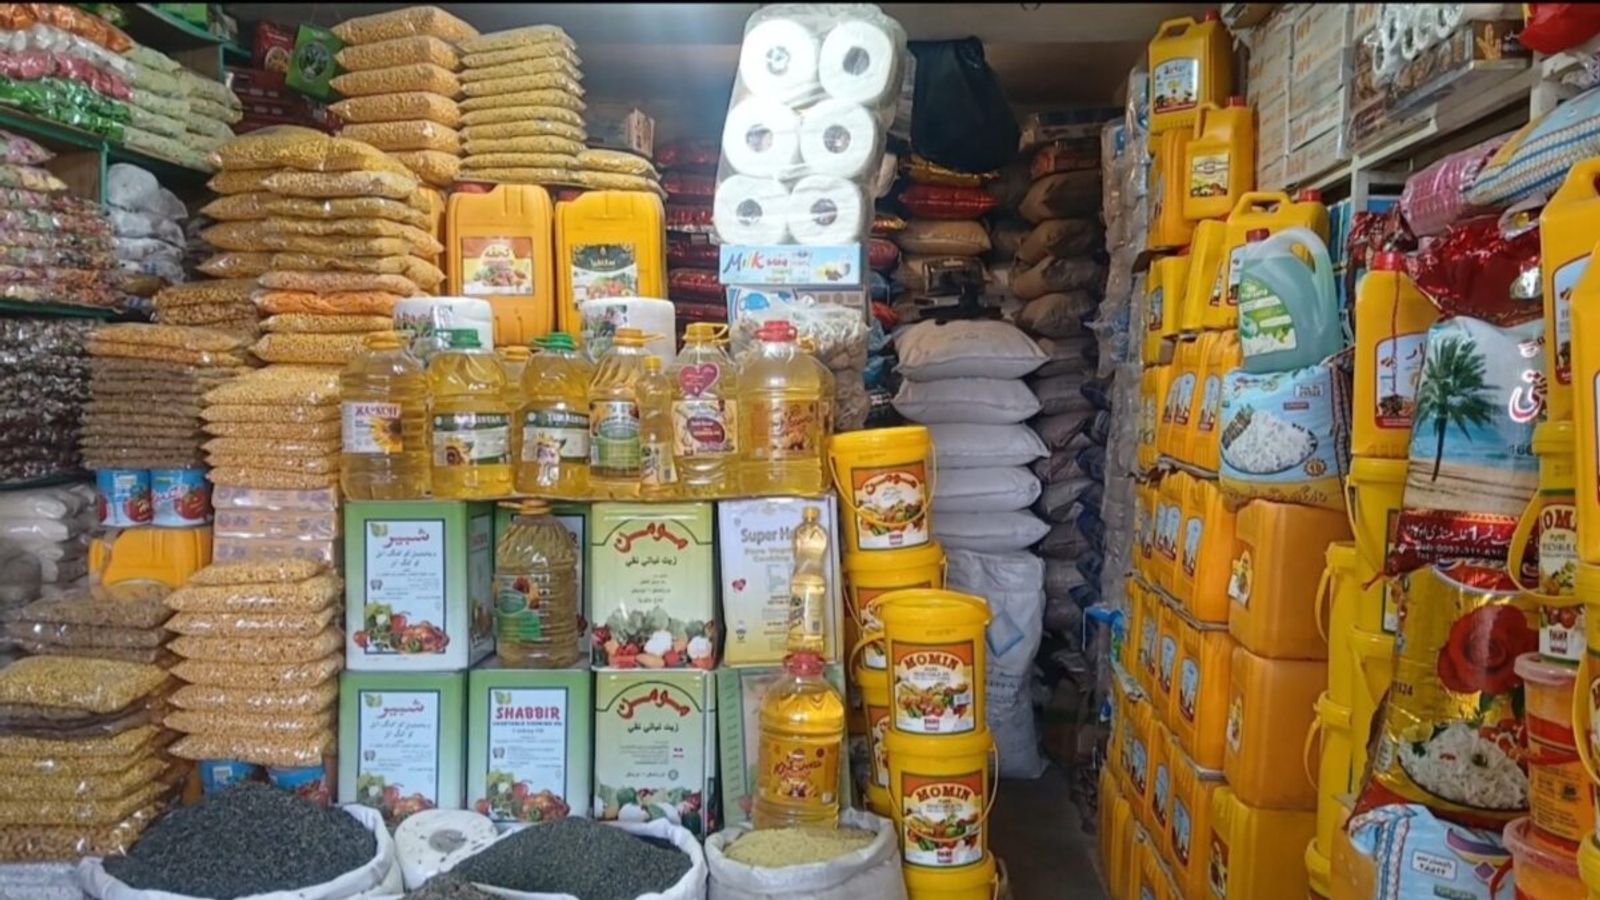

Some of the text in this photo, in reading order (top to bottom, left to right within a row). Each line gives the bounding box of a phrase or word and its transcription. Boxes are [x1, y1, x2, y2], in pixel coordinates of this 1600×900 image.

[741, 528, 777, 545] Super
[904, 653, 959, 671] MOMIN
[495, 706, 560, 720] SHABBIR
[916, 784, 972, 802] MOMIN
